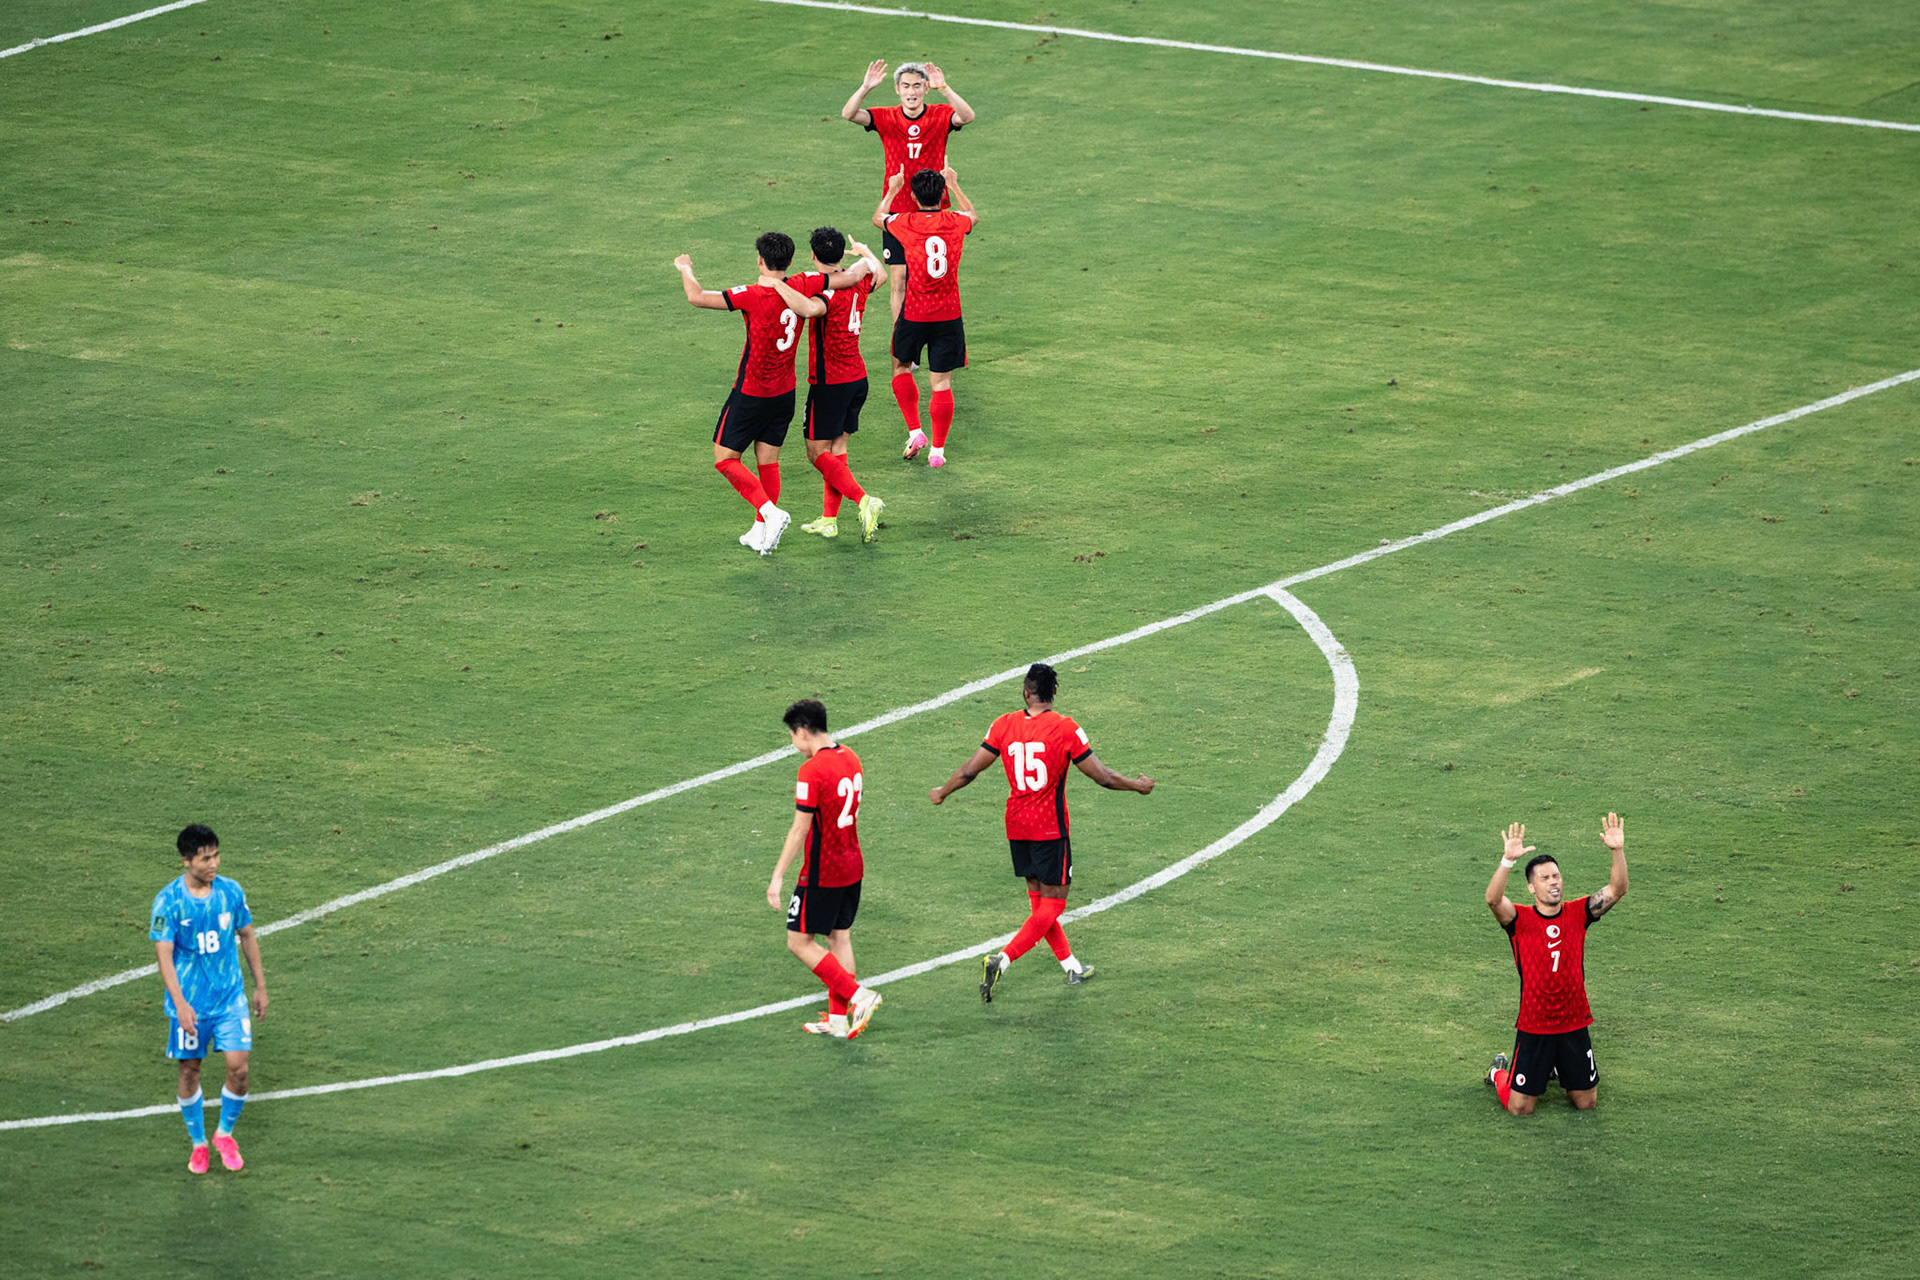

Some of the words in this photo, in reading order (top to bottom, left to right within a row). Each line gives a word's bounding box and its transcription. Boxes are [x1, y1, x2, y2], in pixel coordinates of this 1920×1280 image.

[907, 143, 922, 159] 17
[925, 236, 948, 279] 8
[848, 292, 861, 335] 4
[776, 308, 797, 352] 3
[1008, 741, 1048, 791] 15
[788, 894, 800, 916] 3
[197, 930, 220, 954] 18
[1551, 950, 1560, 972] 7
[177, 1026, 199, 1050] 18
